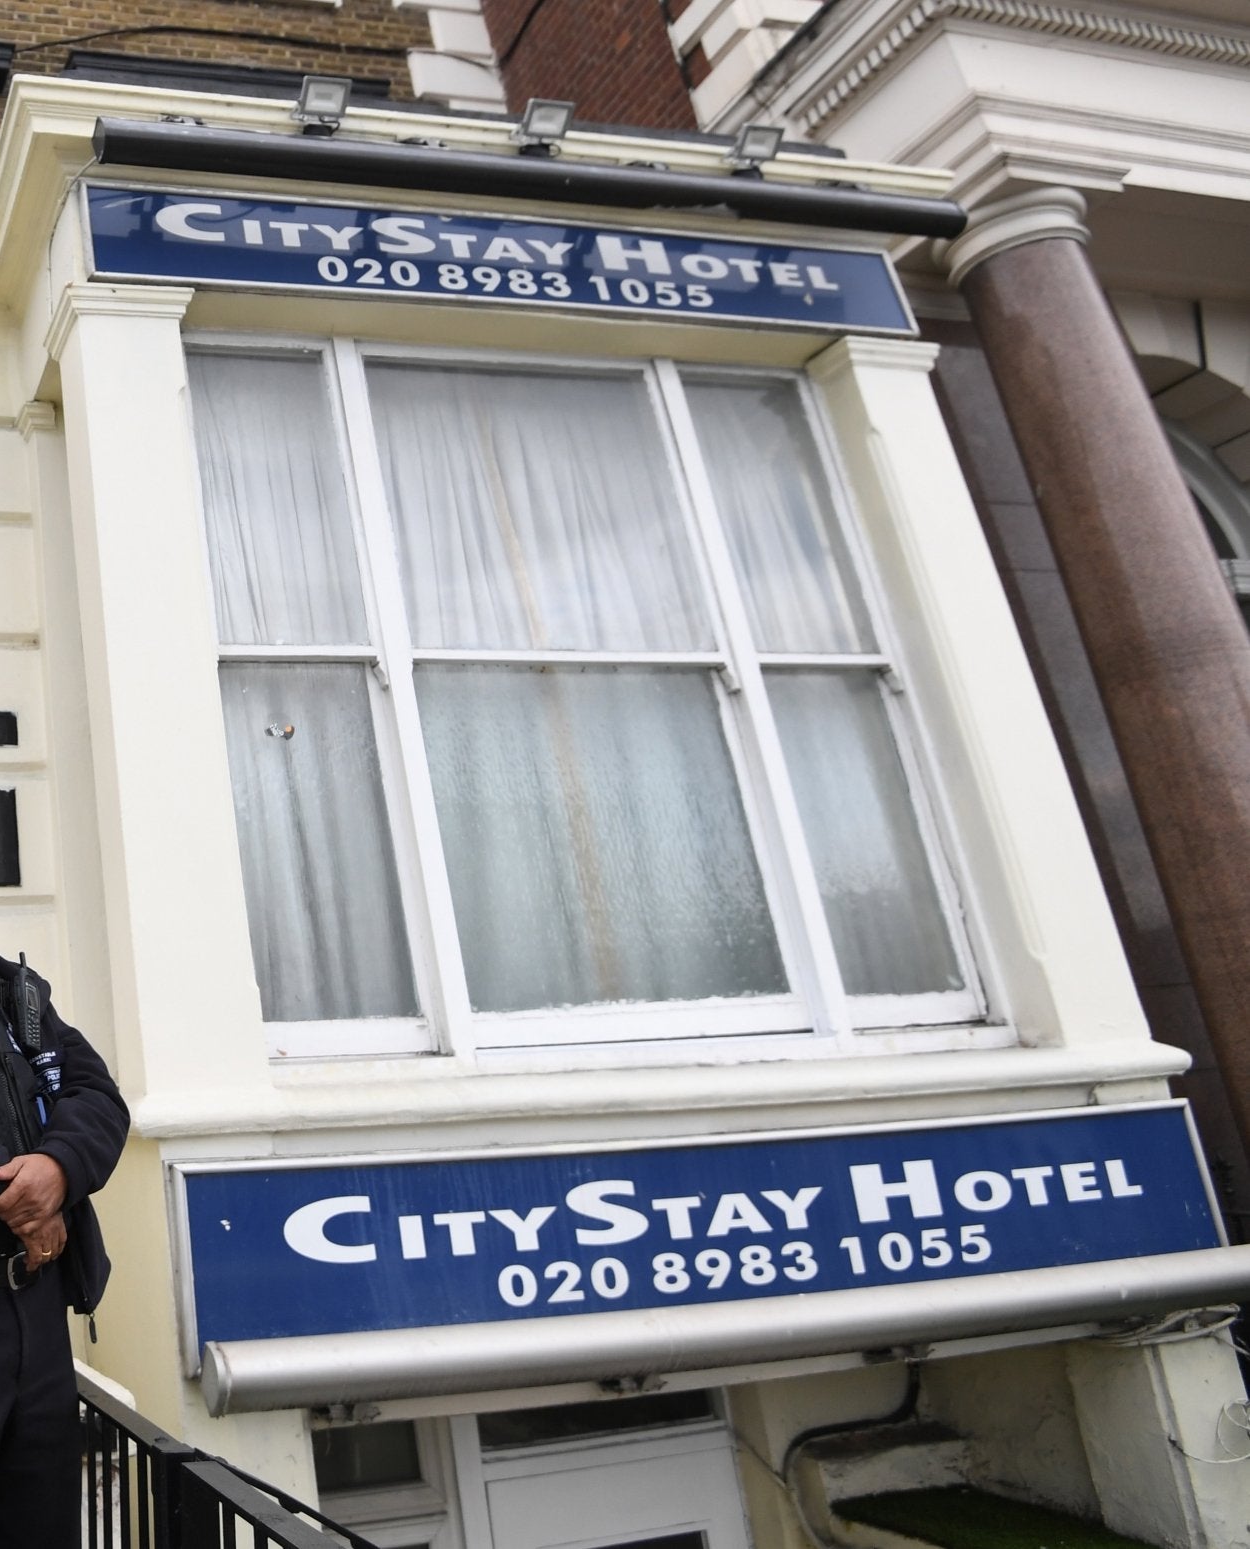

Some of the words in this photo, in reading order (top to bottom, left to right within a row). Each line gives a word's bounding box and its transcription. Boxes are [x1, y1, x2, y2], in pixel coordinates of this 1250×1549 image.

[317, 256, 421, 287] 020
[438, 264, 572, 298] 8983
[588, 276, 714, 308] 1055
[596, 235, 838, 291] HOTEL
[849, 1158, 1143, 1224] HOTEL
[497, 1256, 630, 1307] 020
[651, 1241, 819, 1294] 8983
[838, 1224, 993, 1275] 1055
